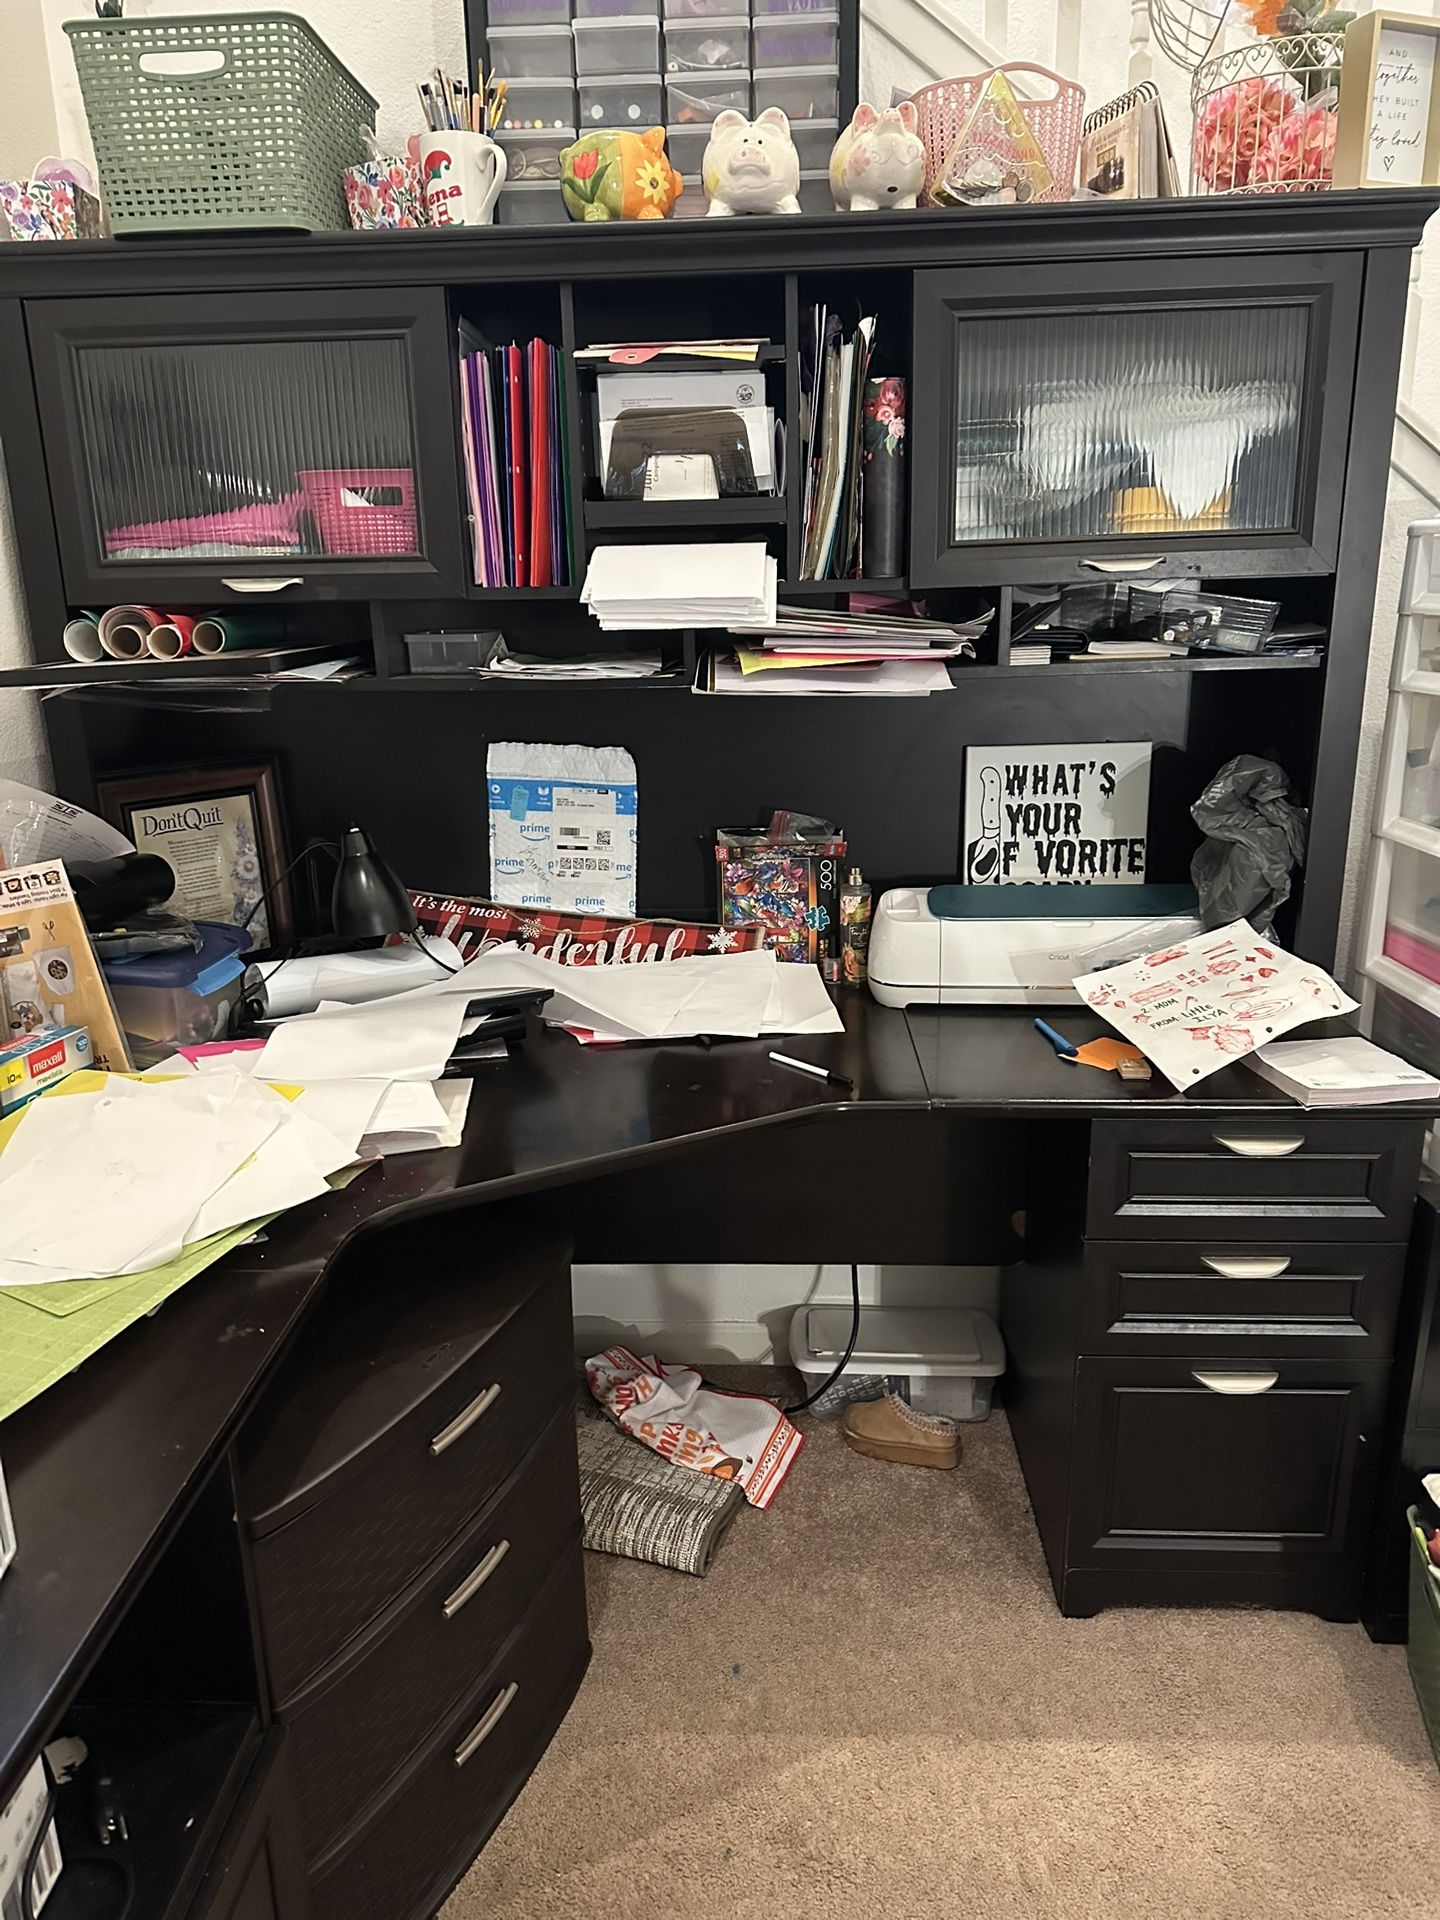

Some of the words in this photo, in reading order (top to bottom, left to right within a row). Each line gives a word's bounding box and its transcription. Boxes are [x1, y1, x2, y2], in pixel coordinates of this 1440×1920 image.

[1389, 49, 1408, 58] AND
[1373, 95, 1390, 104] HEY
[1395, 97, 1420, 107] BUILT
[1388, 112, 1407, 121] LIFE
[1005, 761, 1116, 800] WHAT'S
[141, 813, 185, 837] Don't
[184, 807, 223, 831] Quit
[520, 824, 550, 834] prime
[1005, 803, 1081, 840] YOUR
[494, 858, 525, 868] prime
[820, 859, 833, 890] 500
[522, 895, 551, 904] prime
[575, 897, 605, 906] prime
[412, 895, 437, 910] It's
[440, 900, 466, 914] the
[469, 906, 510, 920] most
[440, 914, 687, 967] Wderful
[1153, 998, 1179, 1010] MOM
[1192, 1008, 1228, 1023] ILYA
[32, 1050, 63, 1073] maxell
[93, 1054, 110, 1065] TR
[655, 1421, 685, 1456] nks
[674, 1428, 704, 1465] ing
